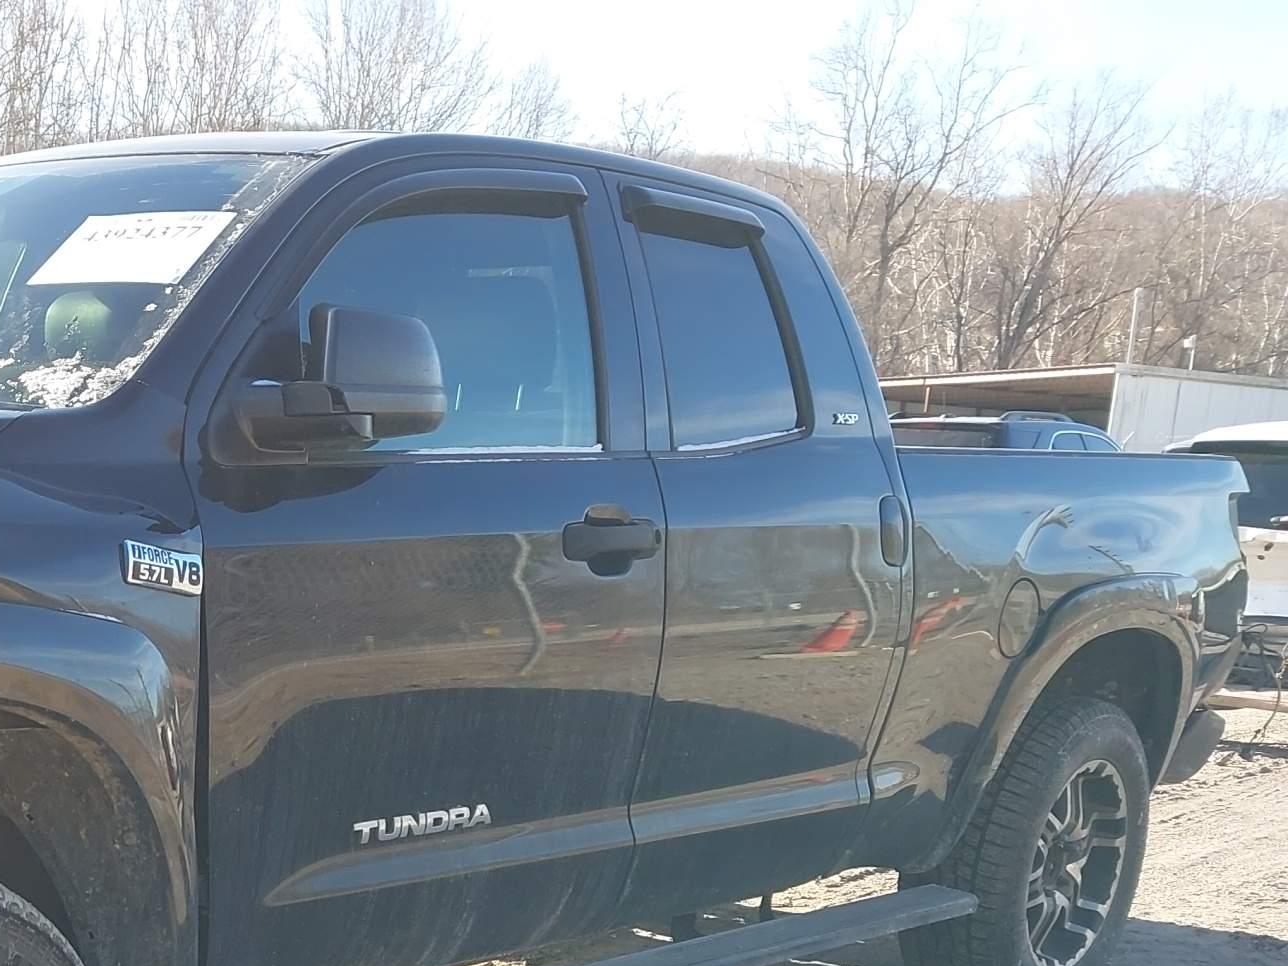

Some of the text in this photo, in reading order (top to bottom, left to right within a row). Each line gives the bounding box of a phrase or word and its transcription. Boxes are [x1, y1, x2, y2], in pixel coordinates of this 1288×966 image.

[139, 563, 169, 584] 5.7L
[174, 558, 201, 587] V8
[353, 803, 492, 845] TUNDRA
